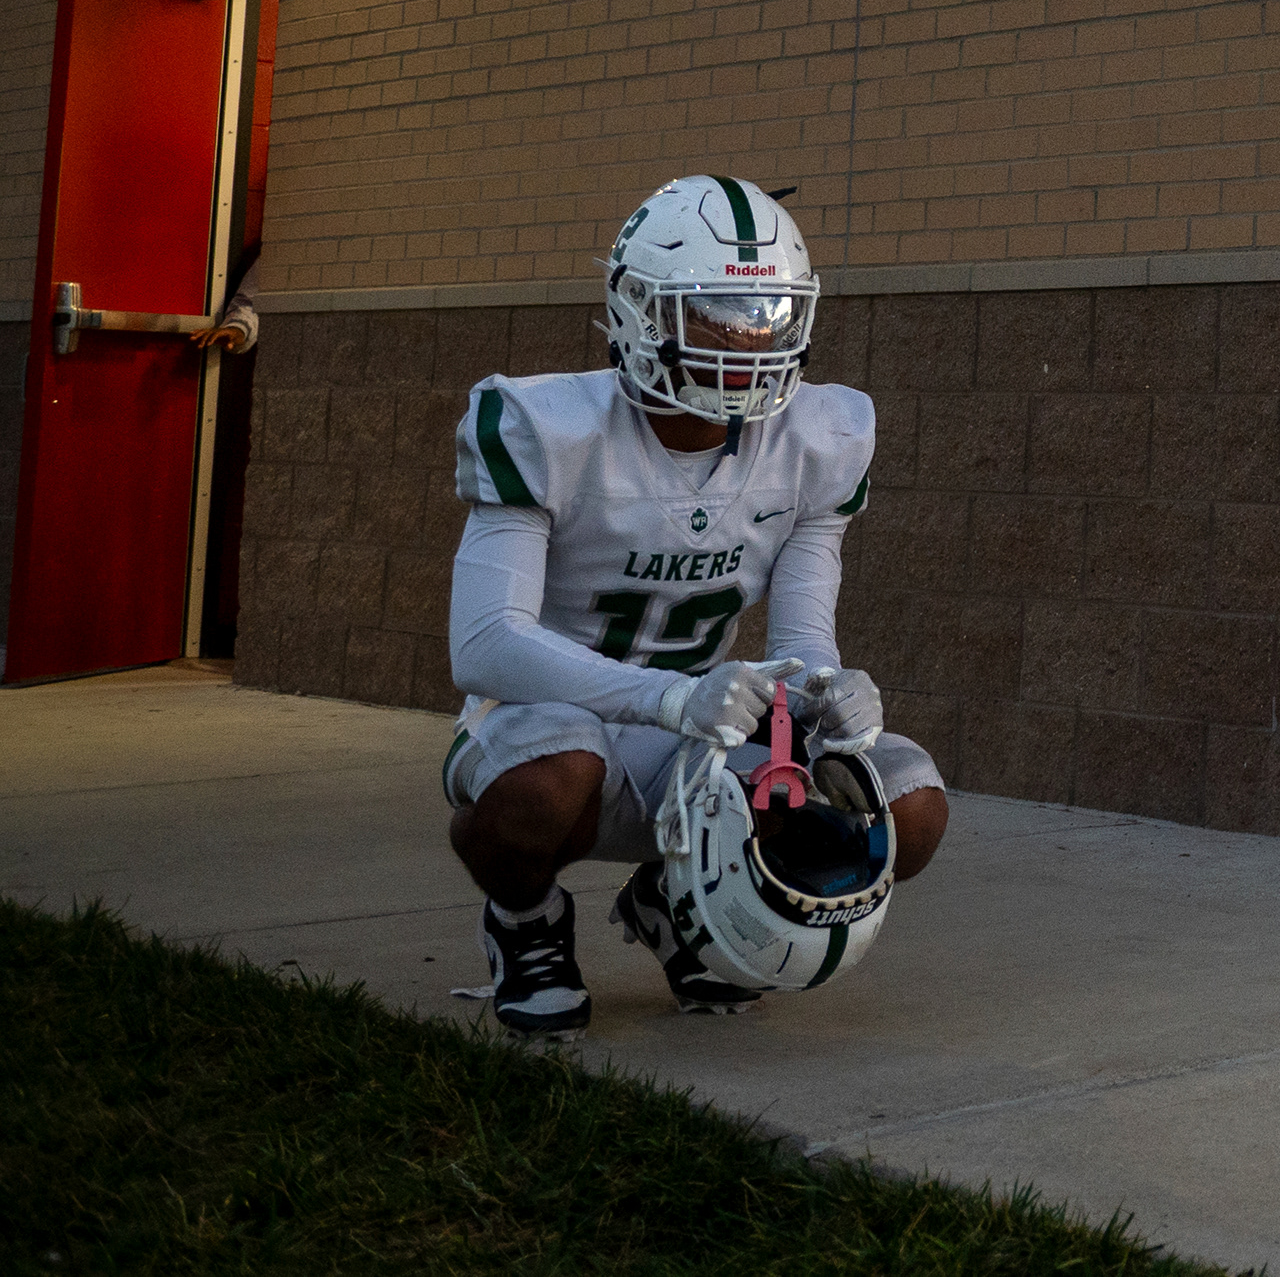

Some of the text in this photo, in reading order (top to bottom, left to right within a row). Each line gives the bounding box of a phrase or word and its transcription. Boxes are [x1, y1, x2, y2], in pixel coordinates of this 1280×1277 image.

[725, 264, 776, 277] Riddell
[623, 544, 745, 581] LAKERS
[588, 581, 748, 676] 12
[806, 897, 878, 926] schutt
